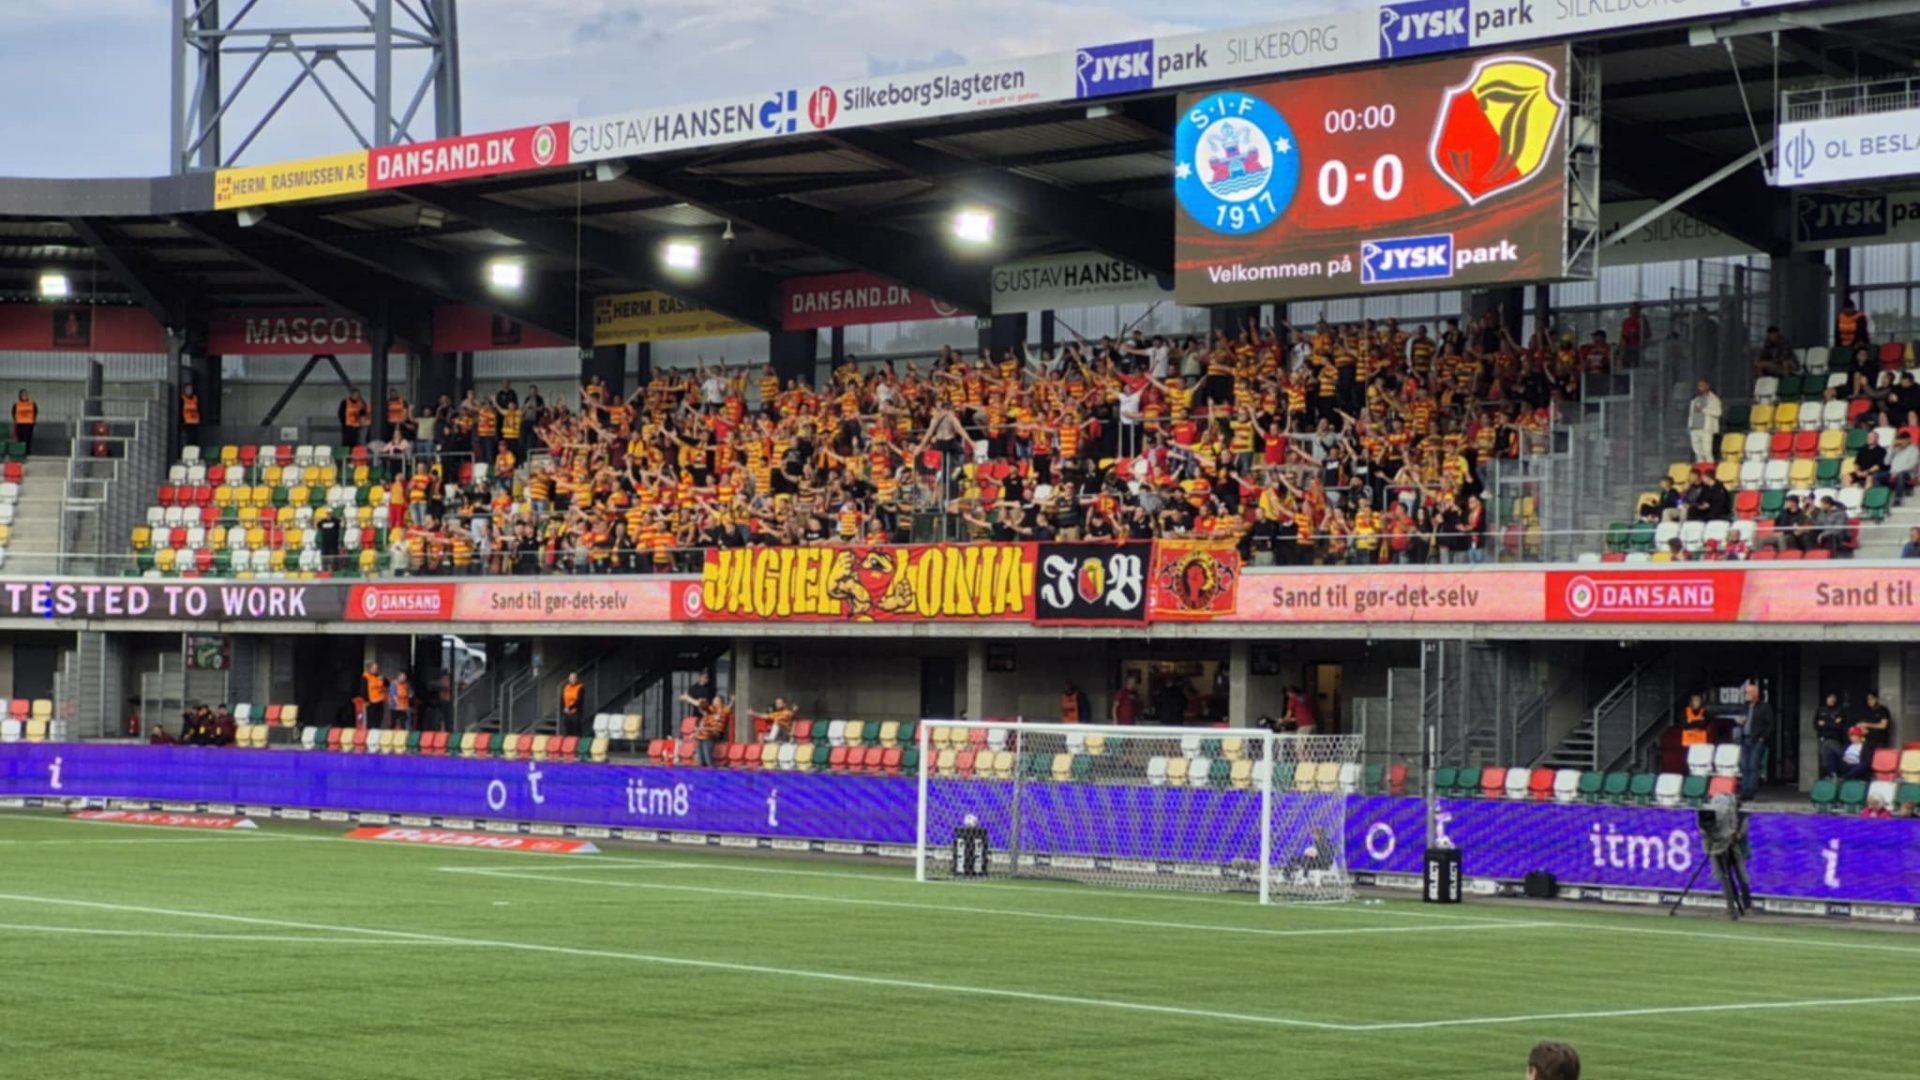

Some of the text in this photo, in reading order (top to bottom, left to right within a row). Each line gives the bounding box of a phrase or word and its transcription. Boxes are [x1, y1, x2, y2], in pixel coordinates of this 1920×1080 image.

[1397, 0, 1534, 42] JYSK park
[1227, 25, 1338, 65] SILKEBORG
[1091, 44, 1208, 82] JYSK park
[843, 70, 1025, 111] SilkeborgSlagteren
[571, 103, 755, 154] GUSTAVHANSEN
[1324, 104, 1396, 134] 00:00
[377, 137, 516, 180] DANSAND.DK
[1824, 140, 1854, 159] OL
[233, 177, 267, 195] HERM.
[271, 165, 344, 190] RASMUSSEN
[1216, 191, 1277, 230] 1917
[1815, 197, 1884, 228] JYSK
[1208, 240, 1518, 284] Velkommen på JYSK park
[792, 286, 912, 313] DANSAND.DK
[5, 584, 307, 616] TESTED TO WORK
[381, 595, 441, 610] DANSAND
[491, 592, 628, 614] Sand til gør-det-selv
[1272, 585, 1479, 612] Sand til gør-det-selv
[1602, 586, 1715, 606] DANSAND
[1815, 581, 1913, 606] Sand til
[626, 778, 689, 816] itm8
[1589, 823, 1692, 873] itm8
